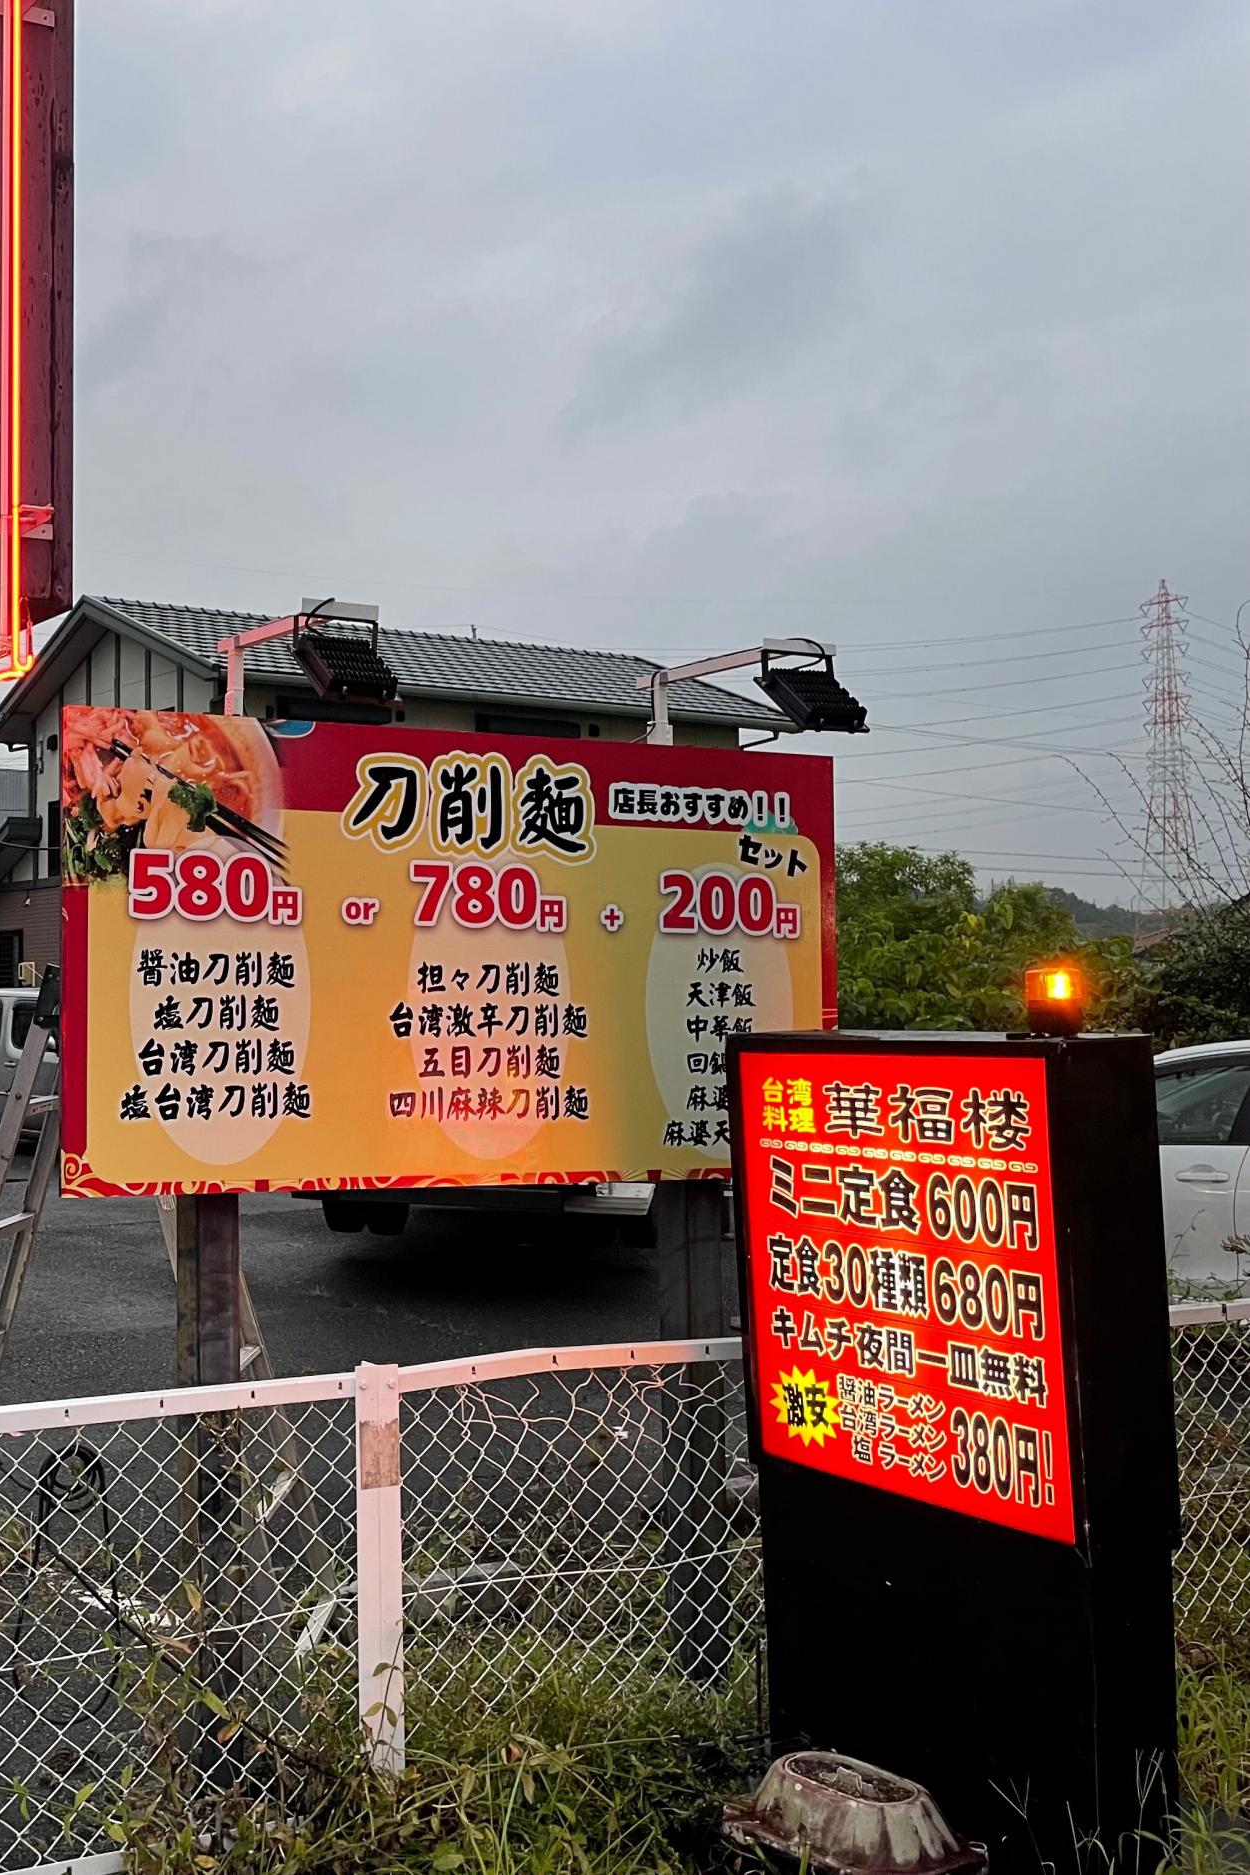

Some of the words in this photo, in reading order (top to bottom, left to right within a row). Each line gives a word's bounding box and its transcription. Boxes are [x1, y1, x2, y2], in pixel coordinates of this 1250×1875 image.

[738, 834, 808, 878] セット
[131, 852, 300, 922] 580円
[346, 900, 377, 921] or
[412, 864, 566, 930] 780円
[662, 873, 798, 935] 200円
[696, 948, 744, 973] 炒飯
[686, 981, 756, 1008] 天津飯
[761, 1077, 813, 1106] 台湾
[762, 1106, 816, 1133] 料理
[823, 1082, 1031, 1150] 華福楼
[770, 1156, 920, 1233] ミニ定食
[928, 1172, 1040, 1250] 600円
[768, 1233, 929, 1318] 定食30種類
[934, 1257, 1045, 1340] 680円
[782, 1383, 829, 1429] 激安
[838, 1404, 947, 1452] 台湾ラーメン
